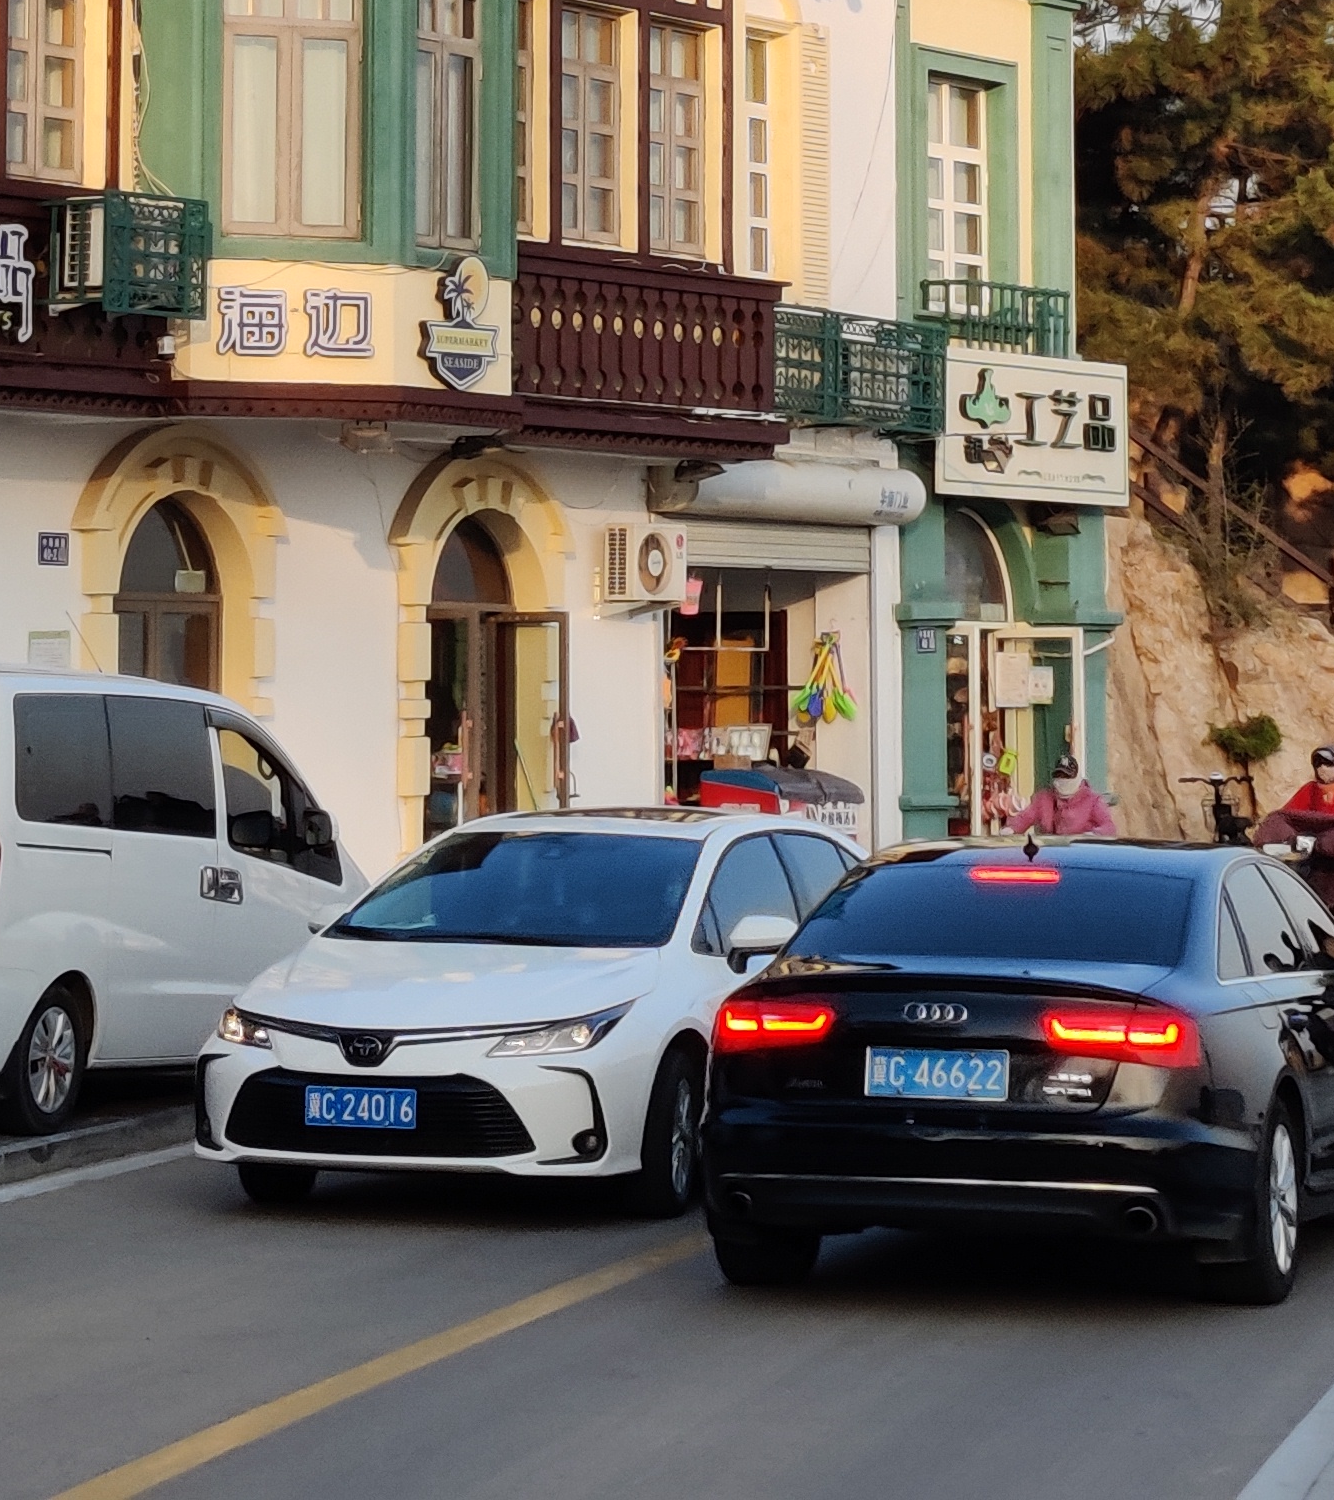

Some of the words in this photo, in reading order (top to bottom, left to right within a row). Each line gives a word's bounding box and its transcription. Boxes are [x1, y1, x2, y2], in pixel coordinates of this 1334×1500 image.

[217, 286, 375, 357] 海边
[436, 334, 489, 347] SUPERMARKET
[443, 356, 479, 369] SEASIDE
[1014, 389, 1117, 452] 工艺品
